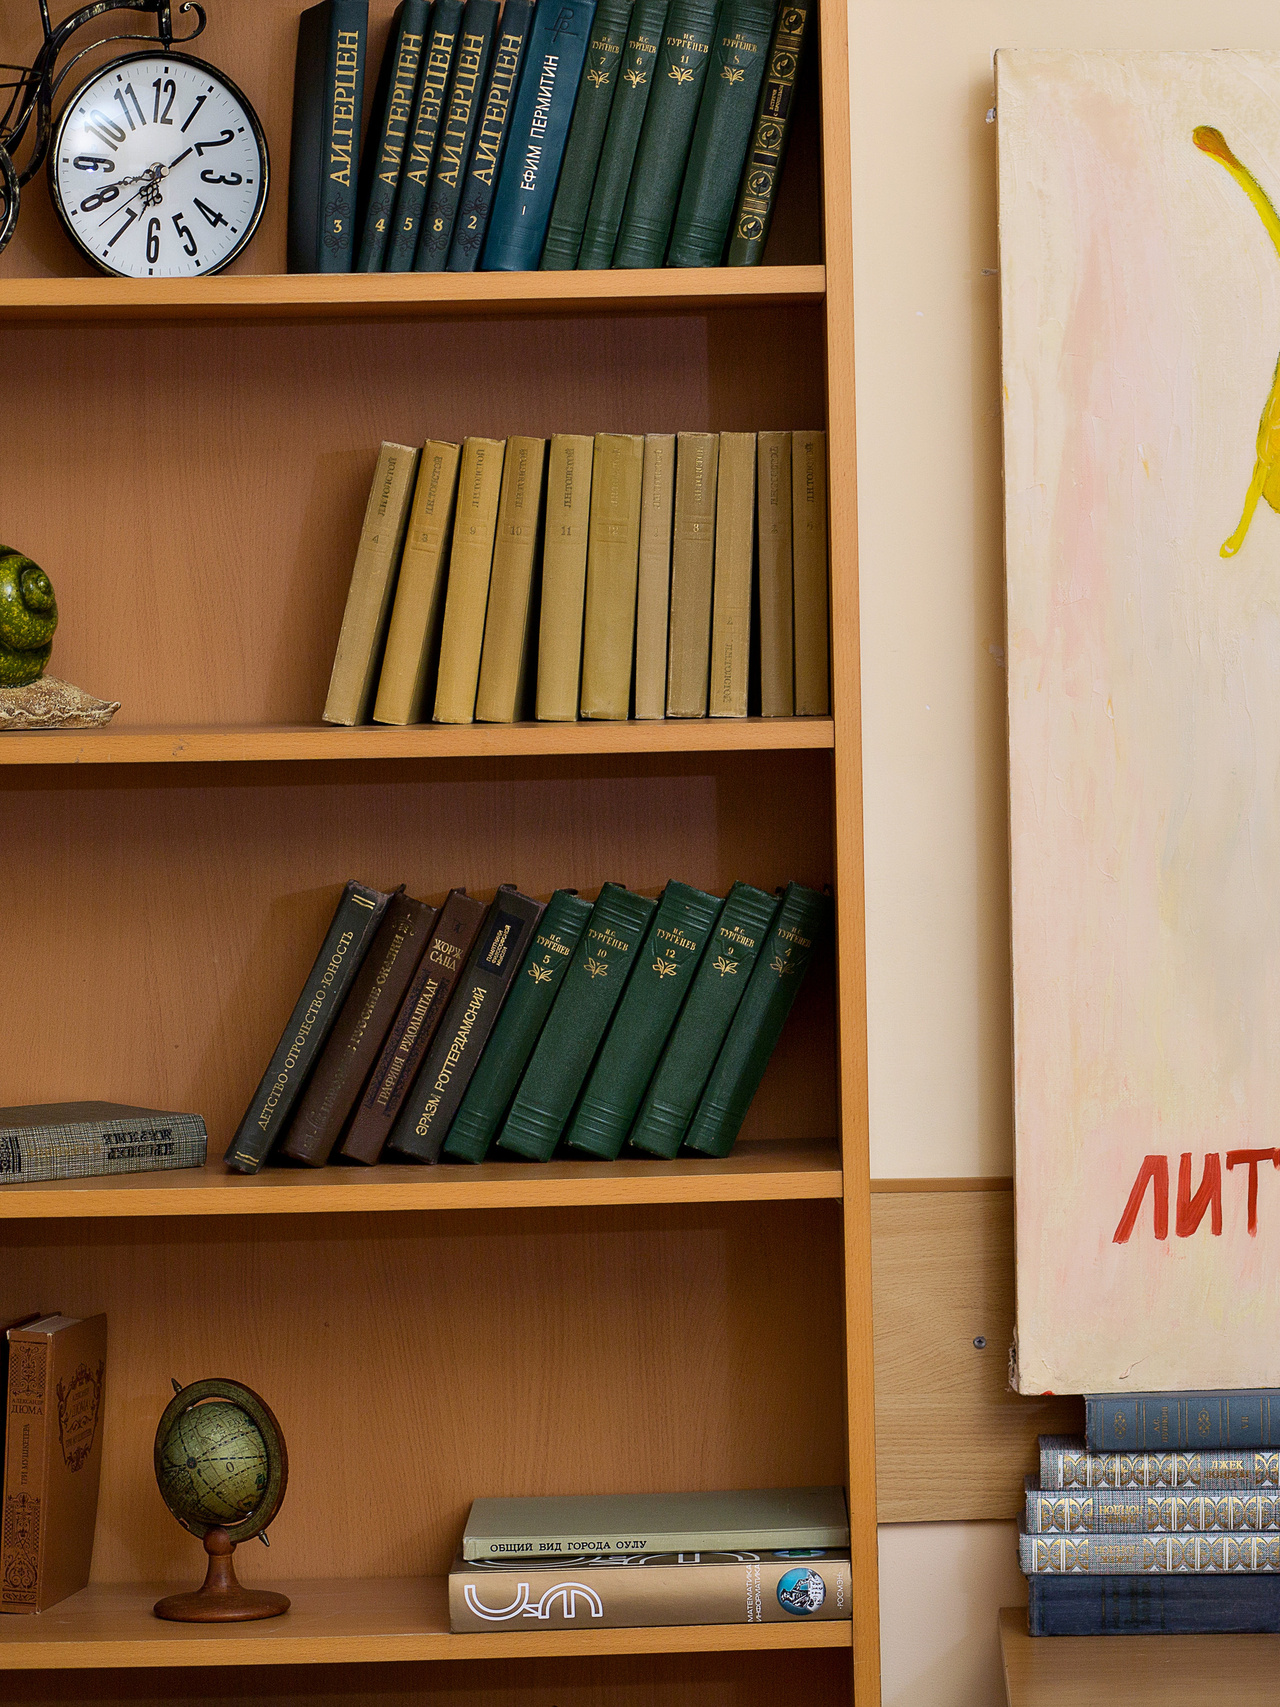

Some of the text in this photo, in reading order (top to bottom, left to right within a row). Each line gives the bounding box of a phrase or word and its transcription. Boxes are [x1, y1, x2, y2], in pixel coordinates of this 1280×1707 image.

[667, 37, 709, 53] ТУРГЕНЕВ
[722, 38, 757, 52] ТУРГЕНЕВ
[600, 56, 606, 65] 7
[636, 57, 643, 65] 6
[680, 55, 690, 64] 11
[733, 55, 740, 64] 8
[114, 82, 147, 131] 11
[152, 78, 177, 126] 12
[330, 30, 359, 187] А.И.ГЕРЦЕН
[378, 31, 423, 187] А.И.ГЕРЦЕН
[406, 30, 455, 187] А.И.ГЕРЦЕН
[437, 32, 485, 189] А.И.ГЕРЦЕН
[472, 34, 523, 186] А.И.ГЕРЦЕН
[181, 94, 207, 133] 1
[520, 54, 560, 191] ЕФИМ ПЕРМИТИН
[84, 109, 126, 152] 10
[194, 129, 235, 157] 2
[73, 155, 116, 173] 9
[199, 169, 242, 186] 3
[80, 185, 120, 213] 8
[193, 197, 229, 229] 4
[403, 217, 414, 231] 5
[467, 215, 478, 230] 2
[106, 208, 138, 248] 7
[172, 212, 198, 257] 5
[333, 219, 343, 233] 3
[375, 218, 386, 233] 4
[433, 218, 444, 231] 8
[146, 217, 161, 264] 6
[561, 526, 571, 536] 11
[693, 523, 700, 533] 8
[536, 934, 571, 956] ТУРГЕНЕВ
[588, 929, 629, 952] ТУРГЕНЕВ
[656, 928, 697, 951] ТУРГЕНЕВ
[720, 927, 755, 948] ТУРГЕНЕВ
[777, 928, 812, 948] ТУРГЕНЕВ
[433, 938, 463, 960] ЖОРЖ
[542, 955, 551, 964] 5
[596, 949, 607, 958] 10
[665, 949, 676, 958] 12
[727, 946, 735, 955] 9
[784, 948, 792, 957] 4
[429, 950, 456, 971] САНД
[257, 931, 354, 1131] ДЕТСТВО ОТРОЧЕСТВО ЮНОСТЬ
[377, 978, 439, 1106] ГРАФИНЯ РУДОЛЬШТАДТ
[415, 1092, 441, 1136] ЭРАЗМ
[1112, 1147, 1280, 1244] ЛИТ
[11, 1405, 43, 1415] ДЮМА
[1161, 1406, 1169, 1443] ПУШКИН
[21, 1424, 30, 1470] МУШКЕТЕРА
[1211, 1460, 1244, 1470] ДЖЕК
[490, 1541, 647, 1553] ОБЩИЙ ВИД ГОРОДА ОУЛУ
[746, 1564, 754, 1622] МАТЕМАТИКА
